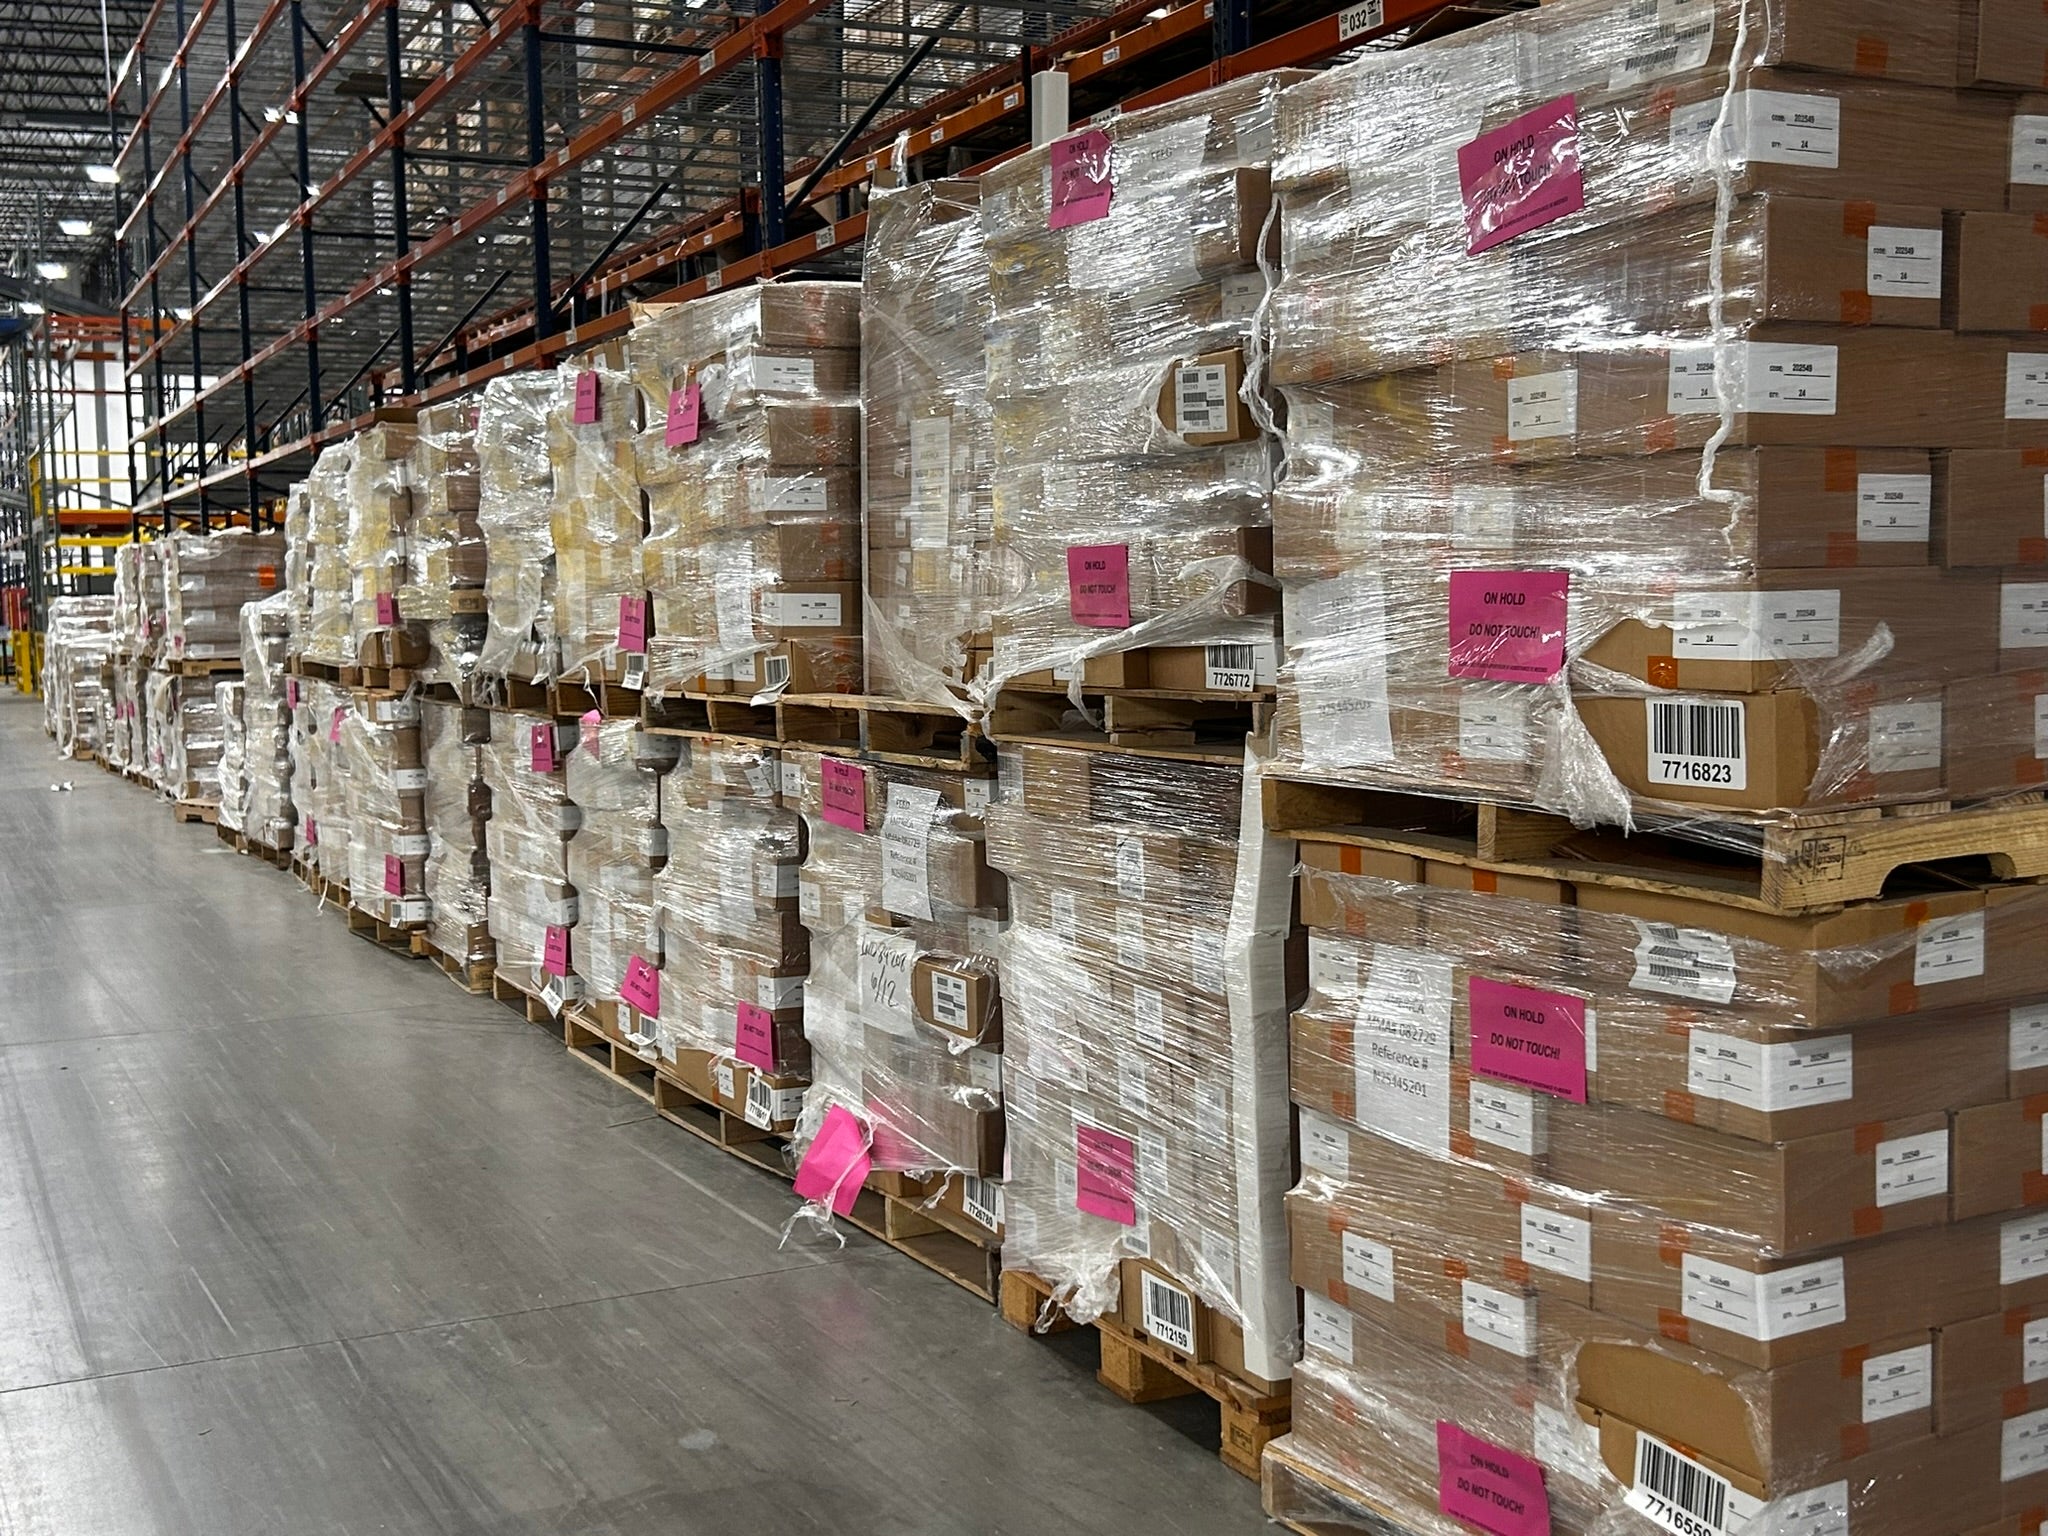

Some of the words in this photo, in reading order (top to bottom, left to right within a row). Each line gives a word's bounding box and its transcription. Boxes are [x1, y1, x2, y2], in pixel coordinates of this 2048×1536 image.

[1350, 9, 1367, 31] 032
[1794, 114, 1815, 124] 202549
[1494, 151, 1508, 164] ON
[1510, 134, 1535, 156] HOLD
[1801, 141, 1808, 149] 24
[1792, 364, 1813, 372] 202549
[1701, 388, 1708, 396] 24
[1798, 389, 1806, 398] 24
[1092, 560, 1106, 570] HOLD
[1484, 592, 1498, 605] ON
[1500, 593, 1526, 606] HOLD
[1469, 624, 1482, 636] DO
[1485, 624, 1501, 637] NOT
[1505, 626, 1541, 638] TOUCH!
[1213, 672, 1250, 688] 7726772
[1662, 760, 1732, 783] 7716823
[1504, 1006, 1518, 1018] ON
[1519, 1008, 1545, 1024] HOLD
[1490, 1032, 1504, 1046] DO
[1505, 1036, 1524, 1051] NOT
[1526, 1040, 1560, 1060] TOUCH!
[1371, 1042, 1420, 1068] Reference
[1421, 1058, 1429, 1070] #
[1156, 1321, 1188, 1348] 7712159
[1470, 1454, 1484, 1468] ON
[1484, 1460, 1510, 1478] HOLD
[1457, 1477, 1470, 1492] DO
[1472, 1482, 1490, 1500] NOT
[1492, 1490, 1524, 1514] TOUCH!
